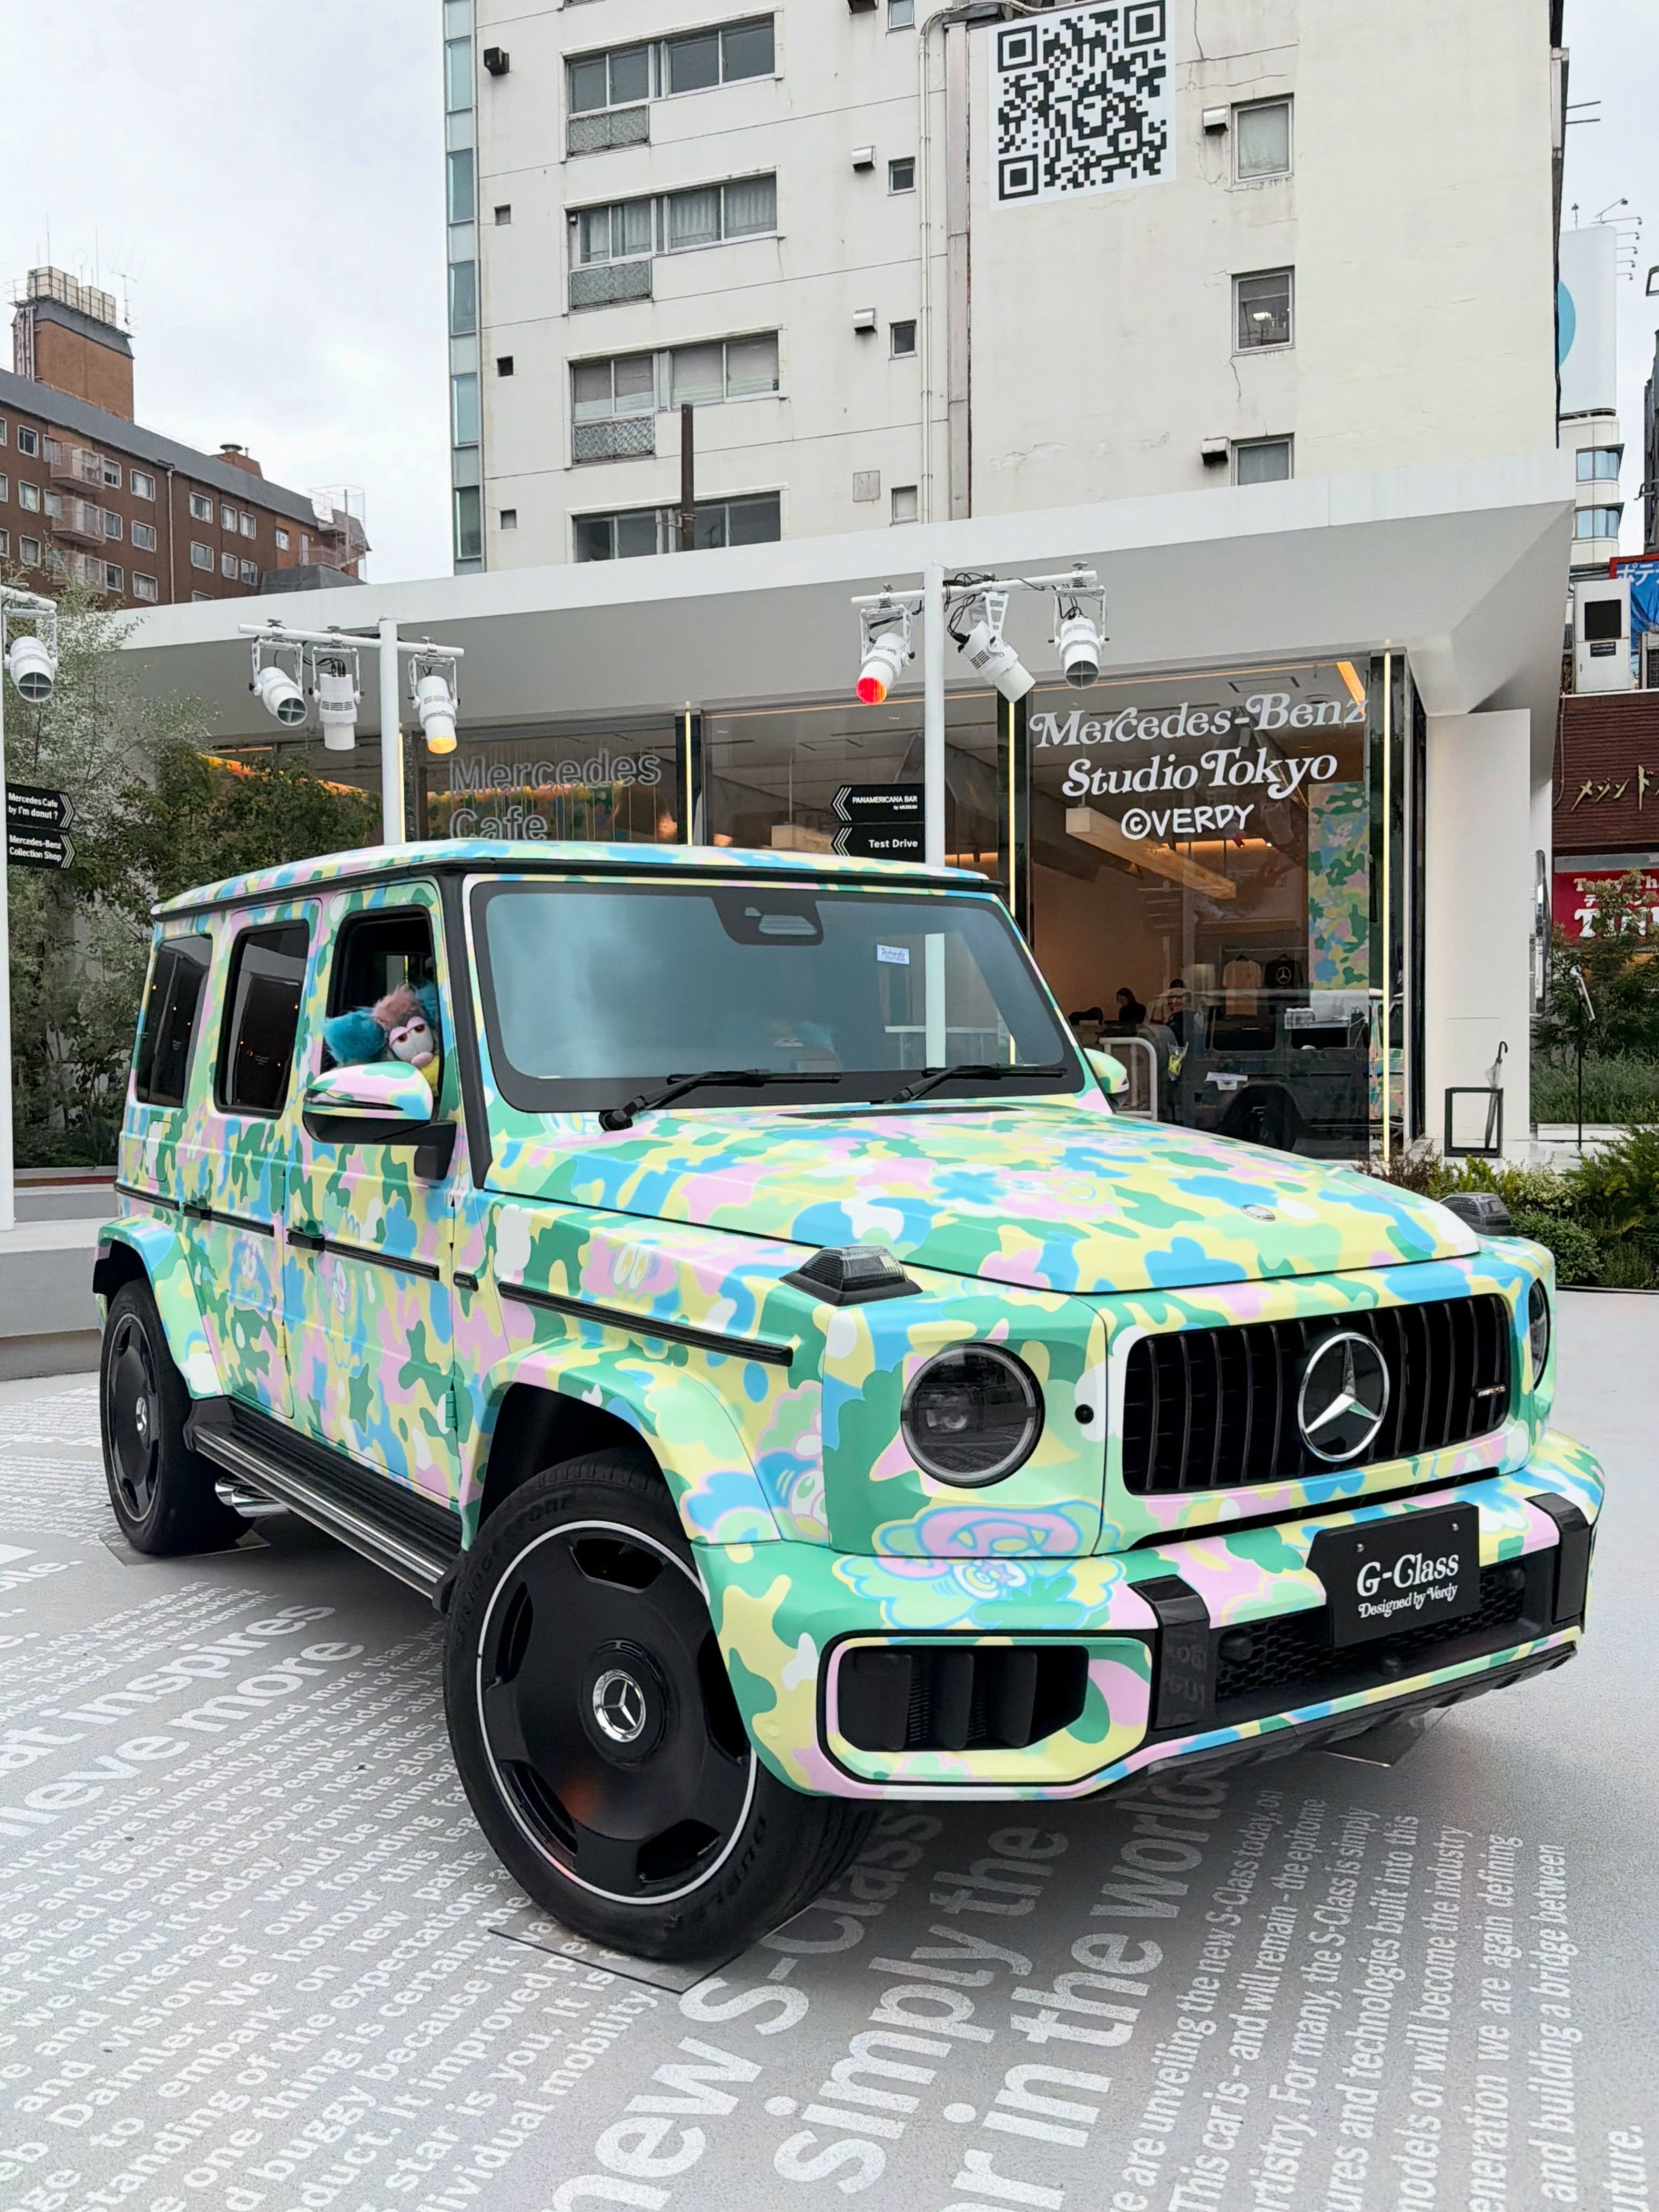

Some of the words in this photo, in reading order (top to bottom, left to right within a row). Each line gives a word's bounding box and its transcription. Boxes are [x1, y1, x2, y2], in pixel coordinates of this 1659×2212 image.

[1616, 562, 1659, 586] ポテ
[1029, 692, 1370, 748] Mercedes-Benz
[8, 792, 42, 805] Mercedes
[42, 798, 58, 808] Cafe
[449, 747, 662, 796] Mercedes
[852, 795, 903, 804] PANAMERICANA
[1062, 753, 1198, 798] Studio
[1201, 746, 1338, 799] Tokyo
[8, 805, 17, 815] by
[18, 806, 29, 816] I'm
[31, 808, 52, 819] donut
[9, 834, 62, 849] Mercedes-Benz
[449, 806, 548, 841] Cafe
[868, 839, 889, 848] Test
[892, 838, 918, 848] Drive
[9, 847, 43, 859] Collection
[44, 851, 62, 862] Shop
[1357, 1553, 1459, 1597] G-Class
[1358, 1592, 1412, 1618] Designed
[1413, 1591, 1427, 1610] by
[1426, 1582, 1458, 1602] Verdy
[21, 1657, 62, 1671] for
[58, 1642, 102, 1655] his
[96, 1586, 232, 1639] Motorwagen.
[26, 1655, 106, 1682] Today
[105, 1638, 143, 1651] we
[144, 1621, 181, 1635] are
[177, 1589, 260, 1617] looking
[52, 1663, 124, 1693] ahead
[118, 1642, 171, 1661] with
[166, 1591, 280, 1640] excitement.
[79, 1610, 140, 1633] years
[38, 1606, 335, 1724] inspires
[166, 1642, 363, 1732] more
[0, 1787, 160, 1878] automobile
[160, 1704, 310, 1782] represented
[307, 1671, 366, 1700] more
[36, 1862, 79, 1875] It
[74, 1822, 146, 1860] gave
[134, 1753, 266, 1818] humanity
[273, 1716, 327, 1742] new
[317, 1687, 378, 1714] form
[373, 1672, 400, 1684] of
[38, 1874, 103, 1910] and
[99, 1812, 204, 1873] greater
[201, 1737, 337, 1811] prosperity.
[325, 1677, 431, 1734] Suddenly
[93, 1803, 272, 1901] boundaries.
[259, 1750, 353, 1797] People
[348, 1716, 409, 1745] were
[1383, 1816, 1419, 1845] this
[22, 1909, 152, 1982] friends
[150, 1868, 215, 1904] and
[211, 1795, 322, 1864] discover
[319, 1762, 376, 1792] new
[372, 1723, 446, 1758] cities
[929, 1826, 1069, 1916] the
[1270, 1863, 1309, 1889] the
[1324, 1860, 1361, 1874] is
[1373, 1851, 1413, 1885] into
[1424, 1825, 1473, 1898] industry
[1476, 1835, 1523, 1906] defining
[11, 1995, 76, 2026] we
[63, 1934, 168, 1990] know
[155, 1913, 200, 1930] it
[188, 1857, 281, 1910] today
[287, 1804, 361, 1842] from
[349, 1776, 400, 1800] the
[1205, 1860, 1258, 1925] S-Class
[1308, 1877, 1357, 1946] S-Class
[1364, 1889, 1408, 1933] built
[1421, 1901, 1459, 1931] the
[1529, 1845, 1576, 1924] between
[14, 2060, 96, 2112] and
[99, 1980, 213, 2047] vision
[218, 1943, 259, 1967] of
[264, 1900, 318, 1934] our
[316, 1815, 444, 1891] founding
[35, 2009, 111, 2055] and
[98, 1924, 238, 2005] interact
[254, 1847, 345, 1901] would
[331, 1824, 379, 1843] be
[1197, 1928, 1235, 1972] new
[1255, 1906, 1297, 1971] remain
[1300, 1950, 1341, 1982] the
[1474, 1916, 1521, 1968] again
[1529, 1929, 1579, 1997] bridge
[45, 2020, 218, 2127] Daimler.
[205, 1972, 278, 2005] We
[269, 1890, 383, 1961] honour
[378, 1850, 439, 1882] this
[89, 2117, 144, 2147] to
[158, 2005, 292, 2097] embark
[295, 1965, 343, 1991] on
[344, 1910, 409, 1952] new
[412, 1851, 496, 1900] paths
[236, 2053, 280, 2085] of
[269, 2014, 335, 2052] the
[330, 1883, 497, 2008] expectations
[1010, 1933, 1163, 2046] the
[1176, 1977, 1220, 2012] the
[1236, 1973, 1279, 2010] will
[1342, 1938, 1405, 2078] technologies
[1409, 1937, 1457, 2020] become
[1480, 1978, 1511, 2014] are
[183, 2129, 262, 2187] one
[252, 2048, 362, 2119] thing
[335, 2022, 385, 2044] is
[379, 1933, 501, 2016] certain:
[476, 1897, 531, 1926] the
[538, 1984, 676, 2096] mobility.
[1229, 2013, 1268, 2060] and
[1291, 1991, 1341, 2056] many,
[1478, 2025, 1510, 2060] we
[1540, 2004, 1570, 2018] a
[246, 2086, 375, 2181] buggy
[355, 1980, 492, 2080] because
[474, 1957, 519, 1974] it
[379, 2094, 432, 2119] It
[408, 1973, 557, 2089] improved
[1139, 2017, 1217, 2132] unveiling
[1405, 2024, 1449, 2070] will
[385, 2125, 458, 2191] star
[444, 2091, 496, 2116] is
[487, 2029, 561, 2084] you.
[542, 1998, 590, 2017] It
[568, 1966, 616, 1991] is
[943, 2064, 1111, 2147] in
[1203, 2081, 1249, 2104] is
[1269, 2059, 1318, 2105] For
[1410, 2076, 1444, 2107] or
[1527, 2023, 1583, 2133] building
[552, 2037, 762, 2212] new
[1202, 2105, 1243, 2150] car
[1335, 2083, 1378, 2138] and
[1122, 2138, 1166, 2186] are
[1168, 2155, 1229, 2212] This
[1528, 2139, 1577, 2202] and
